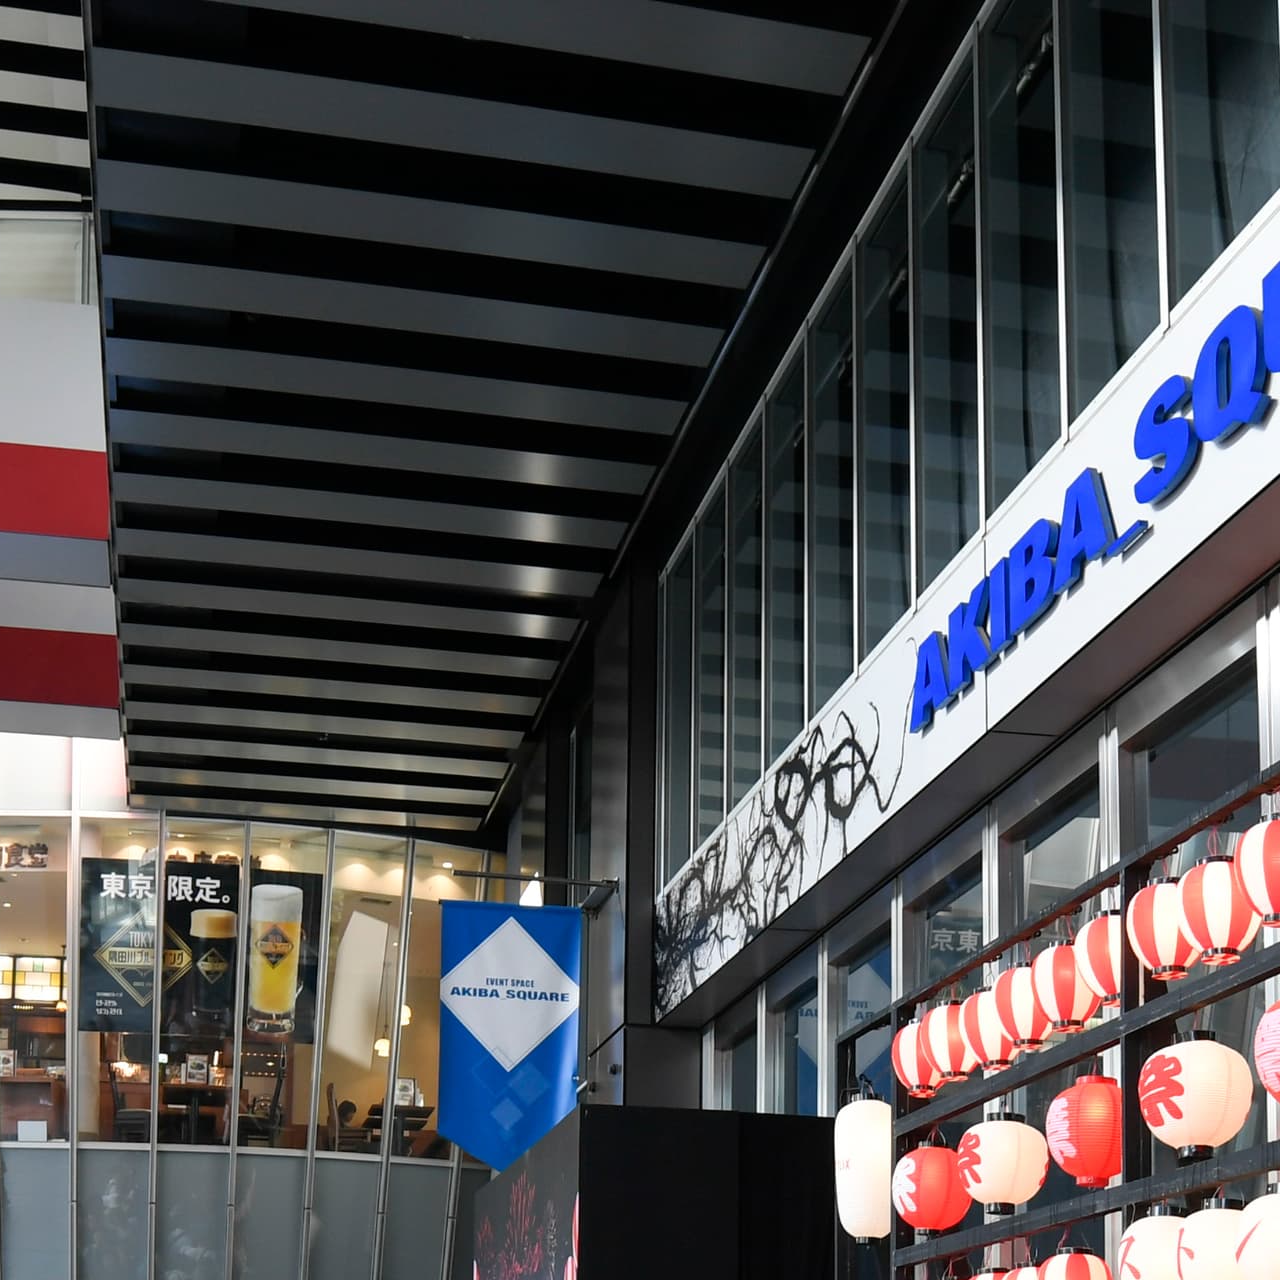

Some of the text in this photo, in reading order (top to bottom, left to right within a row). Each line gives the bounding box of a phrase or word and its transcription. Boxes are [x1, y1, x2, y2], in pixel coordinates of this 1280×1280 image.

[129, 931, 154, 948] TOKY
[486, 977, 534, 988] EVENT SPACE
